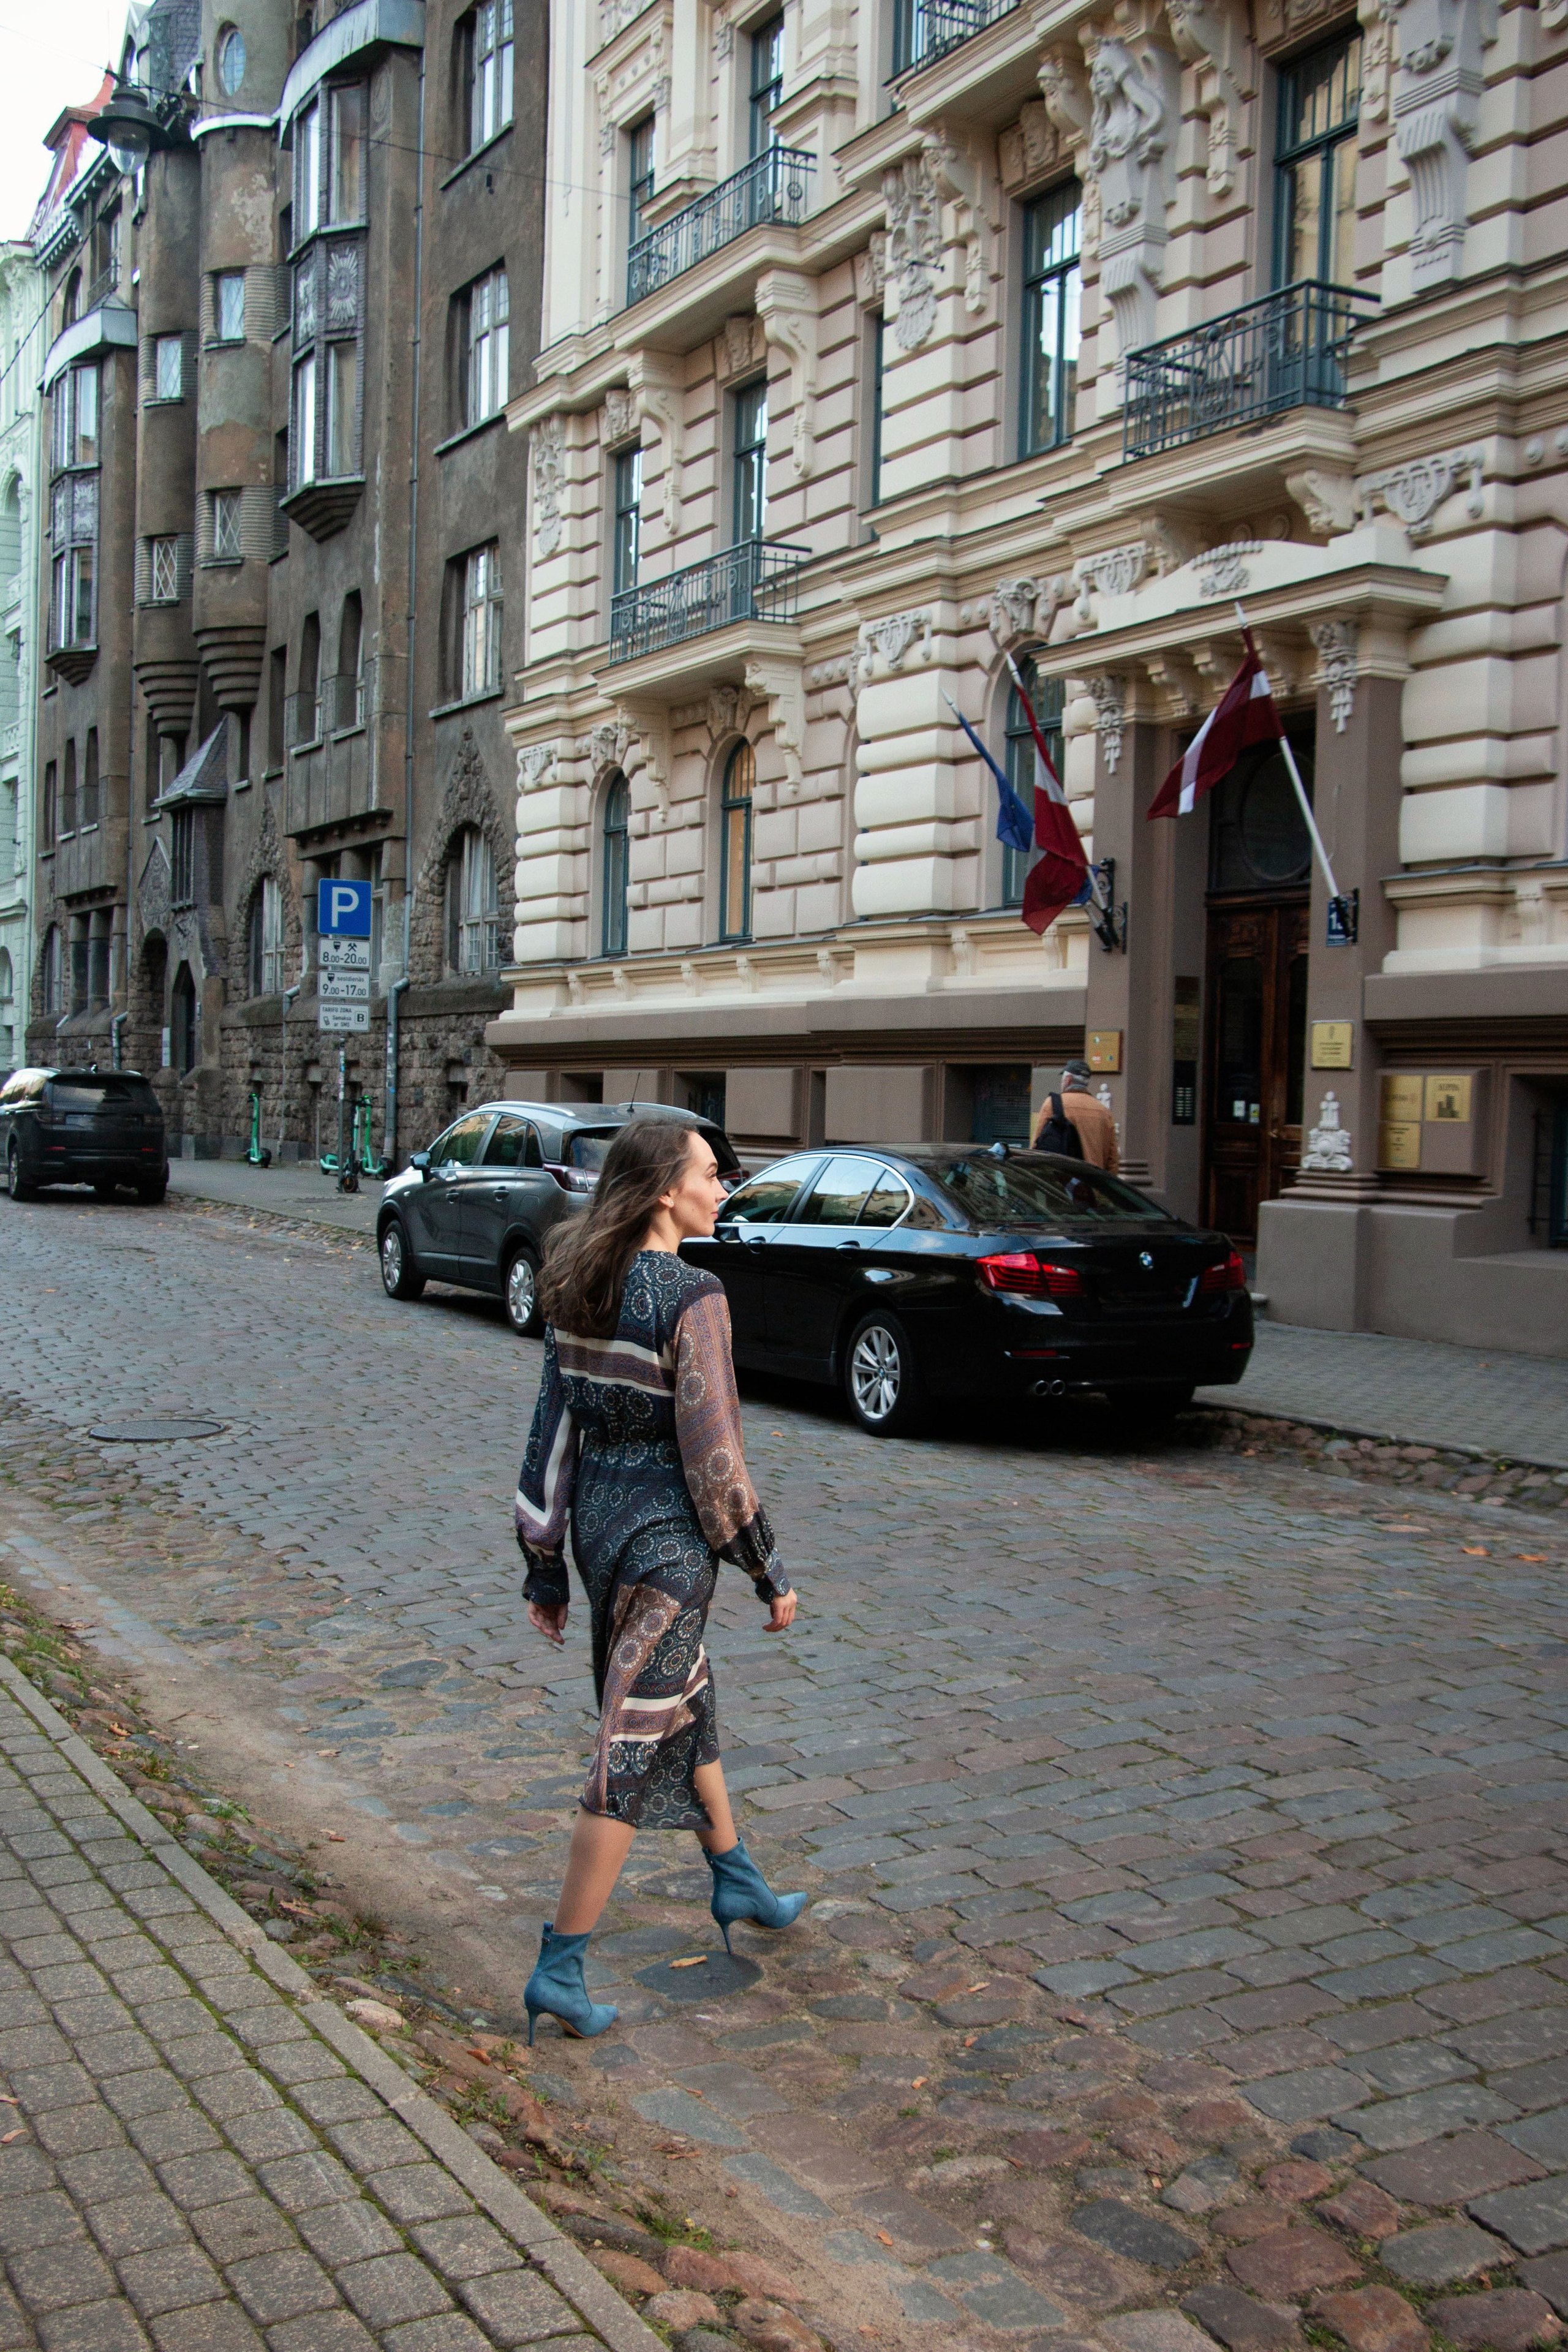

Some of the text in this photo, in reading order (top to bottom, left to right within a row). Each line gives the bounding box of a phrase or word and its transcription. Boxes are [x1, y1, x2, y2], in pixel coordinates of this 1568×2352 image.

[331, 886, 359, 927] P
[323, 951, 367, 965] 8.00-20.00
[357, 1013, 365, 1022] B
